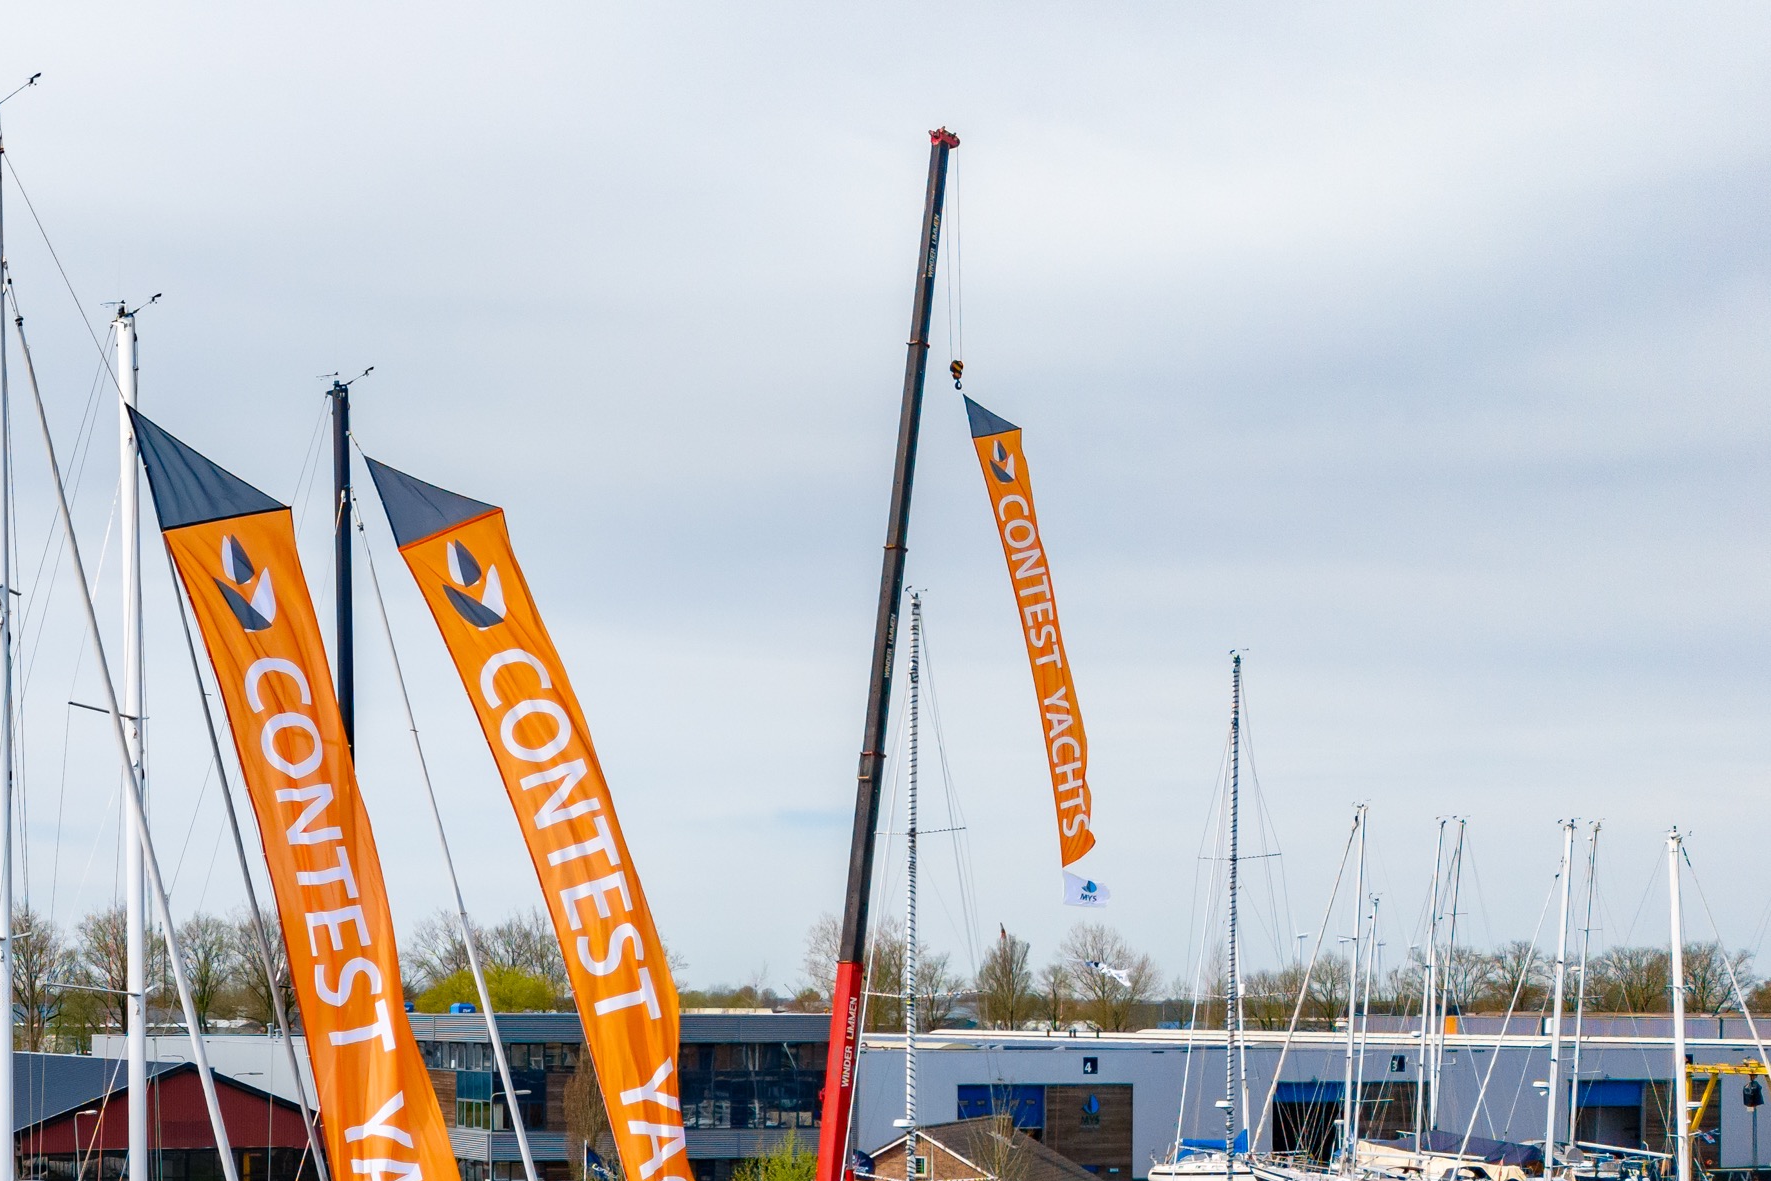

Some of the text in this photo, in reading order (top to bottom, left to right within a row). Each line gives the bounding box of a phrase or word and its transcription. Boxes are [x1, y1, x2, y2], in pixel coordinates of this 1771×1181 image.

[997, 493, 1091, 839] CONTEST YACHTS
[244, 656, 396, 1052] CONTEST
[480, 648, 663, 1020] CONTEST
[1080, 893, 1097, 902] MYS
[841, 996, 858, 1088] WINDER LIMMEN
[1084, 1062, 1092, 1073] 4
[1391, 1060, 1398, 1071] 3
